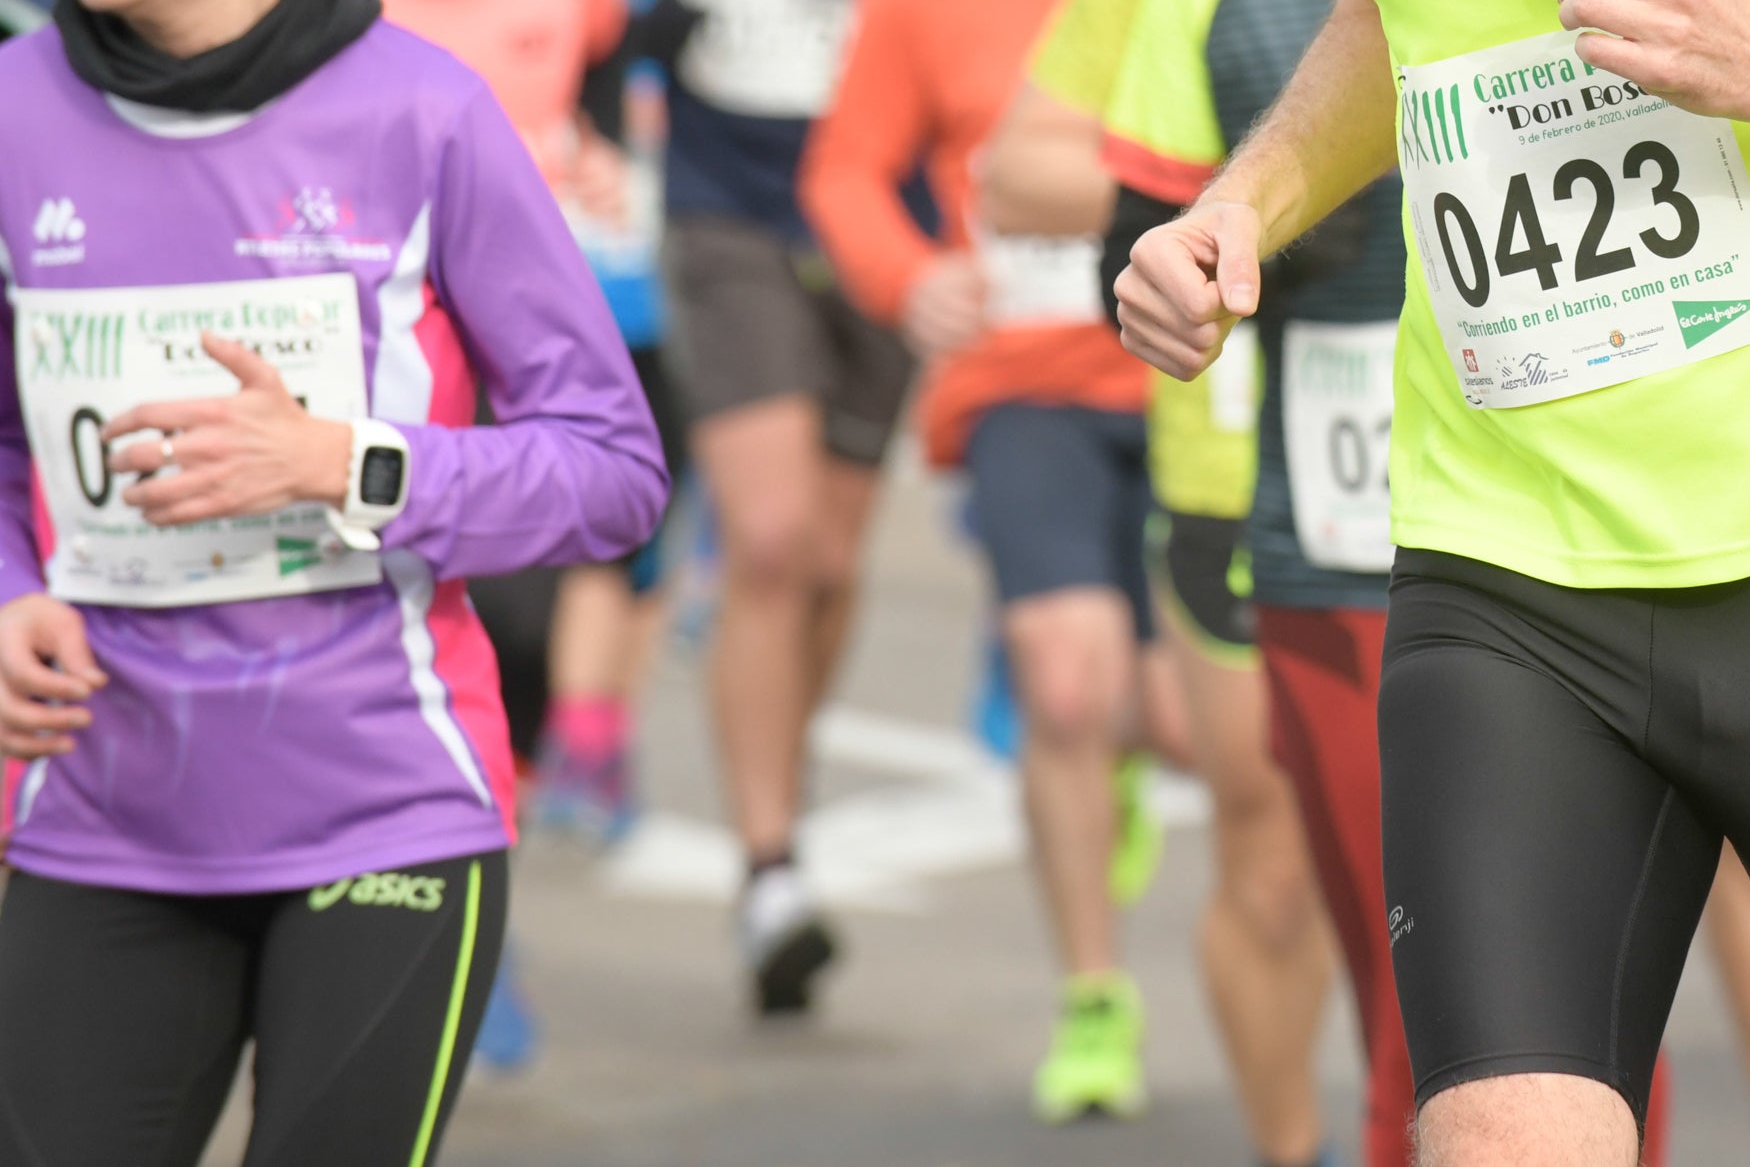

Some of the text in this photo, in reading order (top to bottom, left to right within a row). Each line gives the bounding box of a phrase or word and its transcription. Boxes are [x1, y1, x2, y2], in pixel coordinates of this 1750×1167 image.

[1472, 57, 1577, 103] Carrera
[1518, 135, 1526, 146] 9
[1527, 130, 1541, 144] de
[1542, 122, 1582, 142] febrero
[1583, 118, 1597, 130] de
[1597, 110, 1626, 127] 2020,
[1433, 140, 1701, 308] 0423
[1522, 310, 1541, 328] en
[1545, 305, 1560, 322] el
[1563, 292, 1617, 318] barrio,
[1622, 279, 1665, 303] como
[1670, 273, 1691, 290] en
[1586, 355, 1610, 366] FMD
